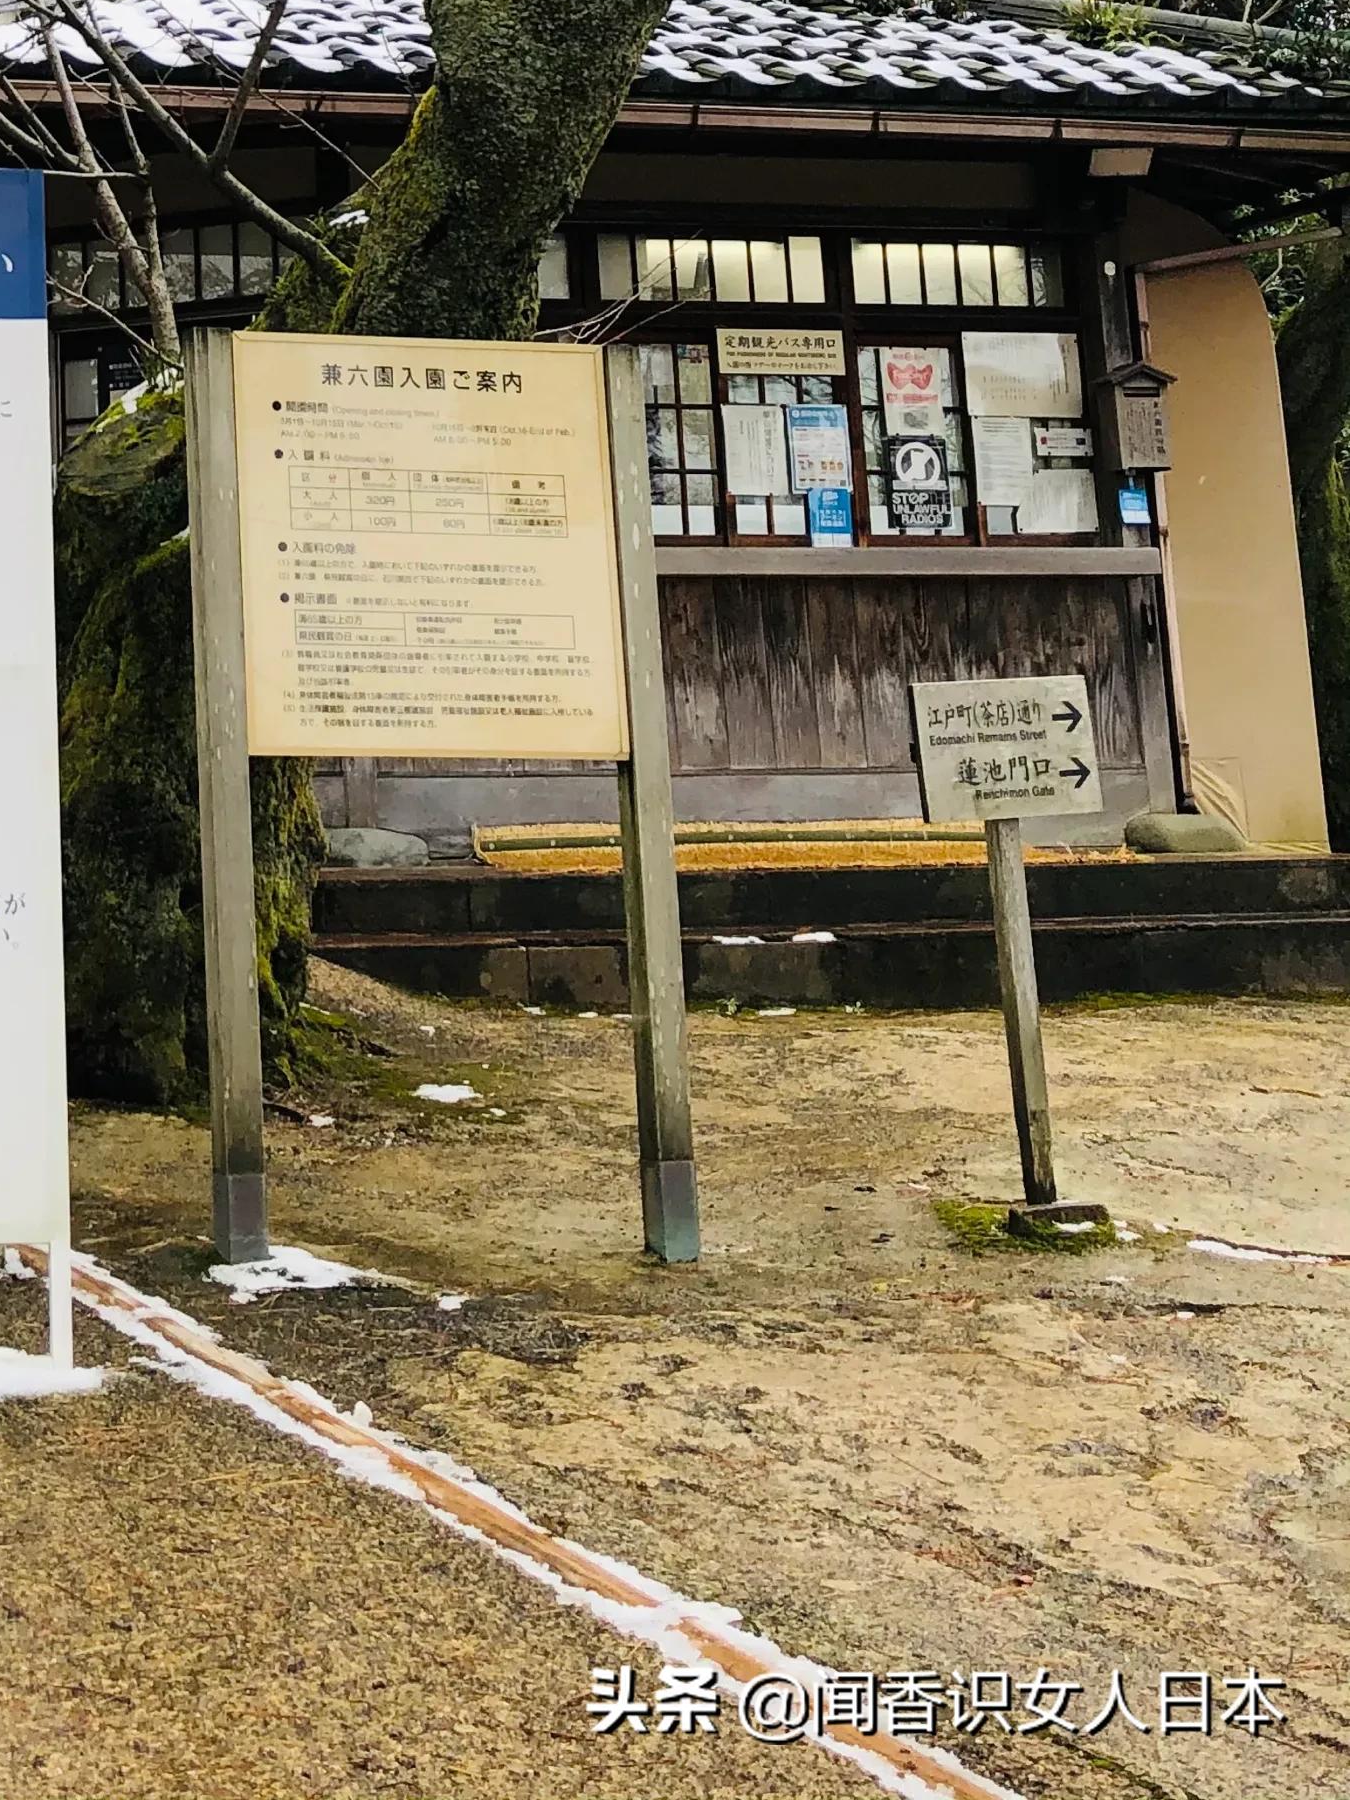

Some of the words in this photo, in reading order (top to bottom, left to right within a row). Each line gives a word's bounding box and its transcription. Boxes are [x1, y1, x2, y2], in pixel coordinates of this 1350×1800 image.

[725, 336, 836, 350] 定期観光バス専用口
[322, 363, 522, 393] 兼六園入園ご案内
[893, 504, 952, 516] UNLAWFUL
[901, 514, 944, 525] RADIOS
[930, 732, 976, 746] Edomachi
[1020, 729, 1047, 741] Street
[958, 755, 1052, 786] 蓮池門口
[1032, 785, 1055, 797] Gate
